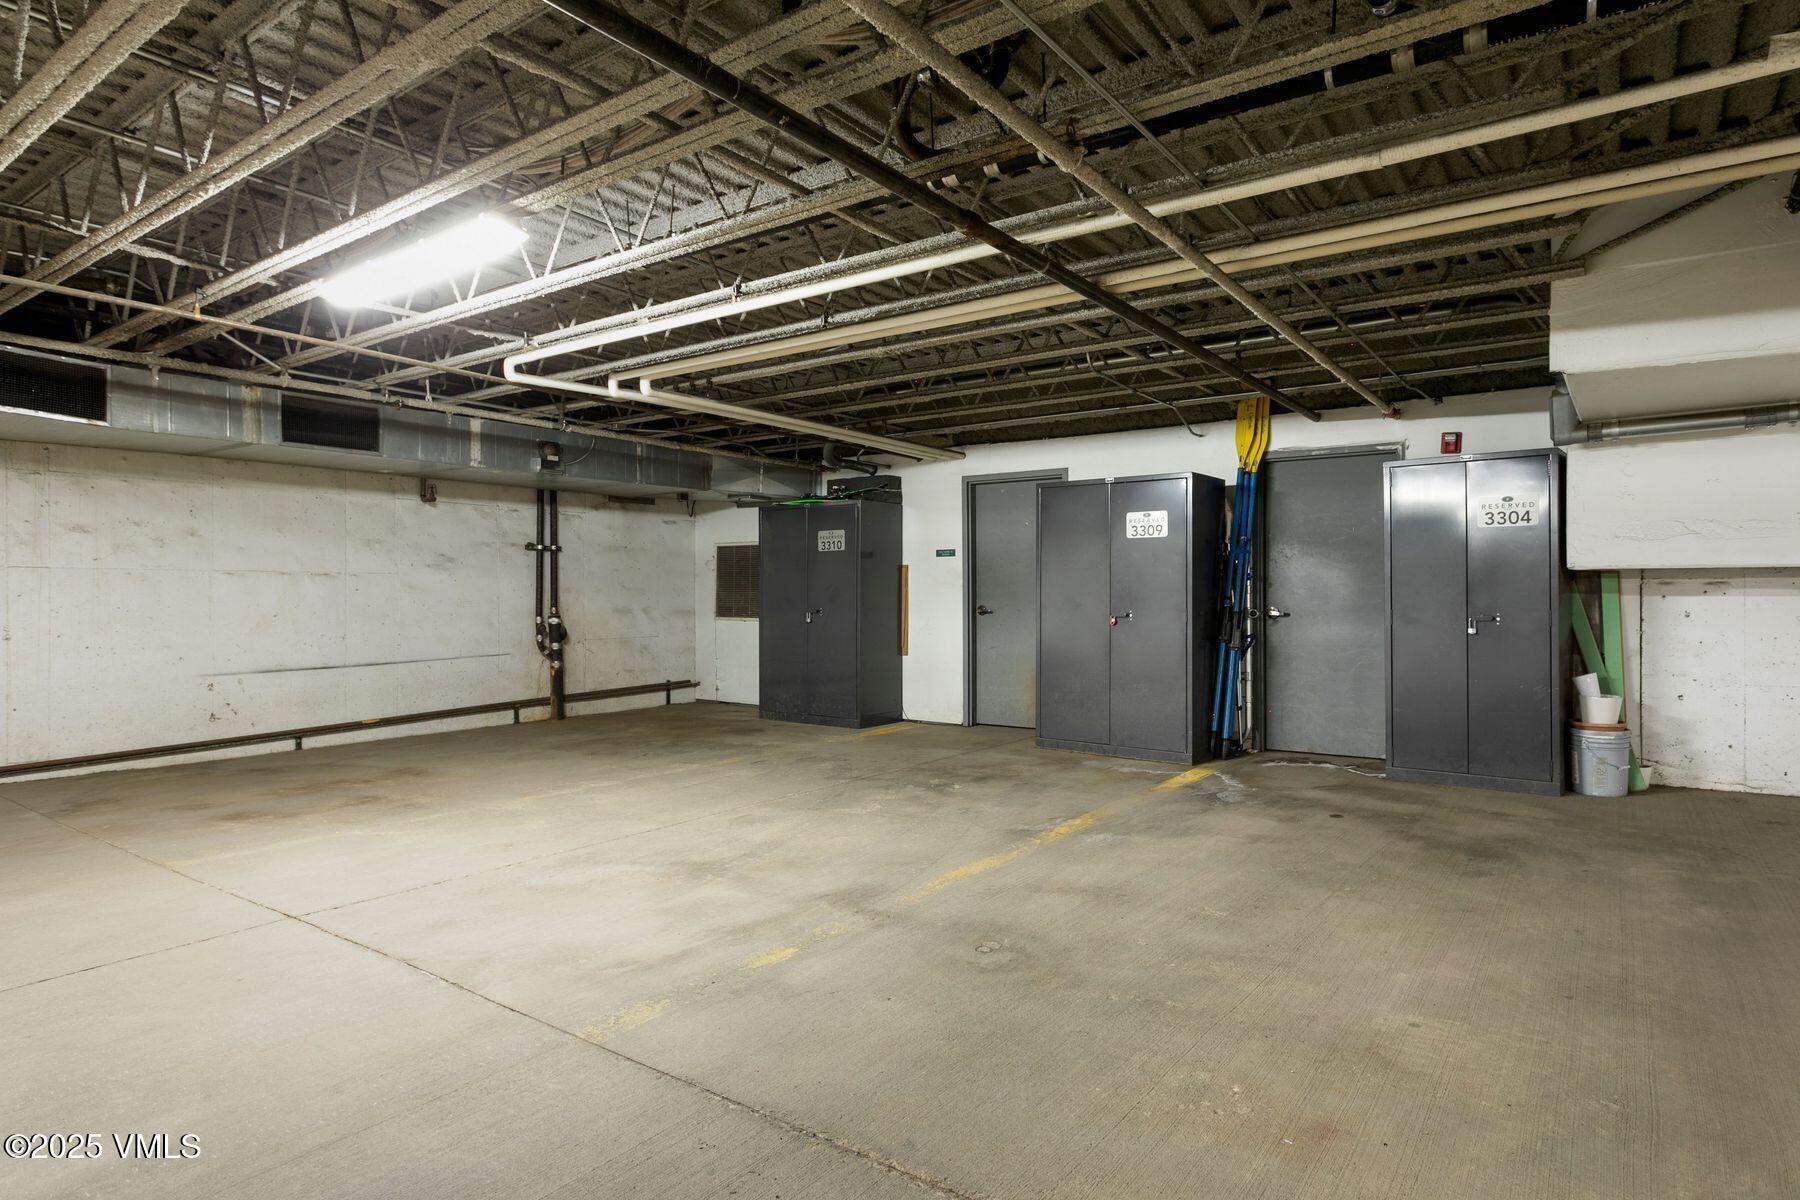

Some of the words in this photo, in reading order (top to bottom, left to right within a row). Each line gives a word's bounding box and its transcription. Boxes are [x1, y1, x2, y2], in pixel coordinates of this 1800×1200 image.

[1481, 501, 1535, 510] RESERVED
[1485, 510, 1532, 525] 3304
[1131, 524, 1162, 536] 3309
[821, 540, 842, 550] 3310
